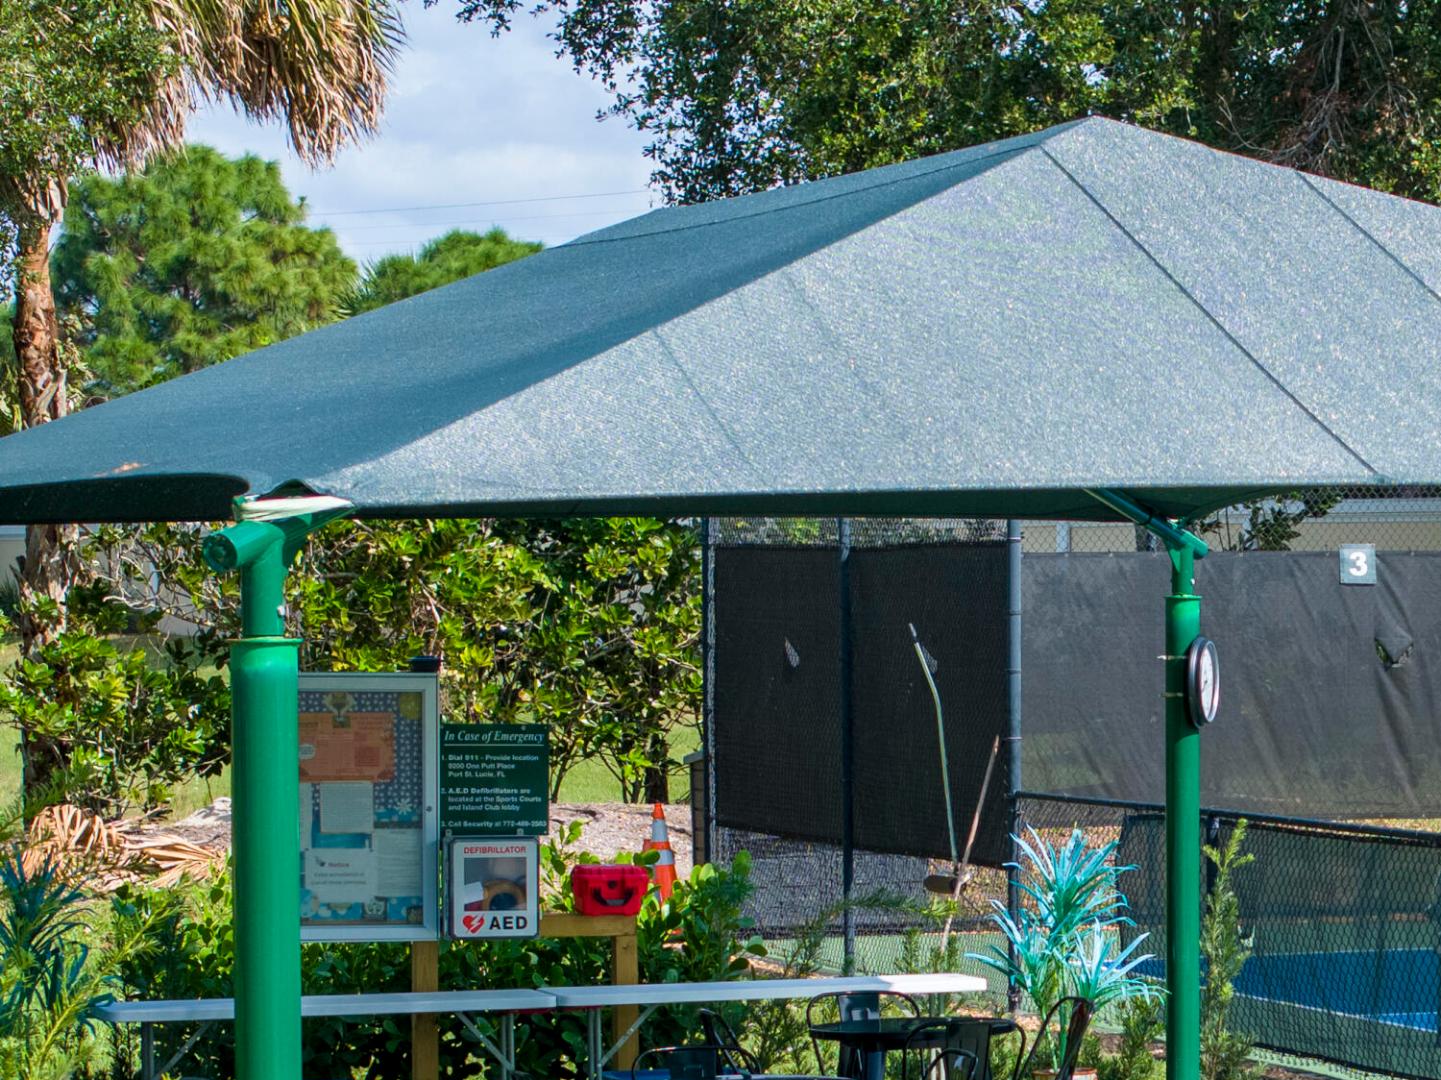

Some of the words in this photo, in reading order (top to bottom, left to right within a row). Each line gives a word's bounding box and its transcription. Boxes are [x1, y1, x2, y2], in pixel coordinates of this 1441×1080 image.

[1349, 551, 1368, 577] 3
[444, 730, 455, 741] In
[457, 730, 480, 741] Case
[481, 730, 493, 744] of
[493, 730, 545, 744] Emergency
[463, 846, 527, 854] DEFIBRILLATOR
[489, 915, 528, 930] AED
